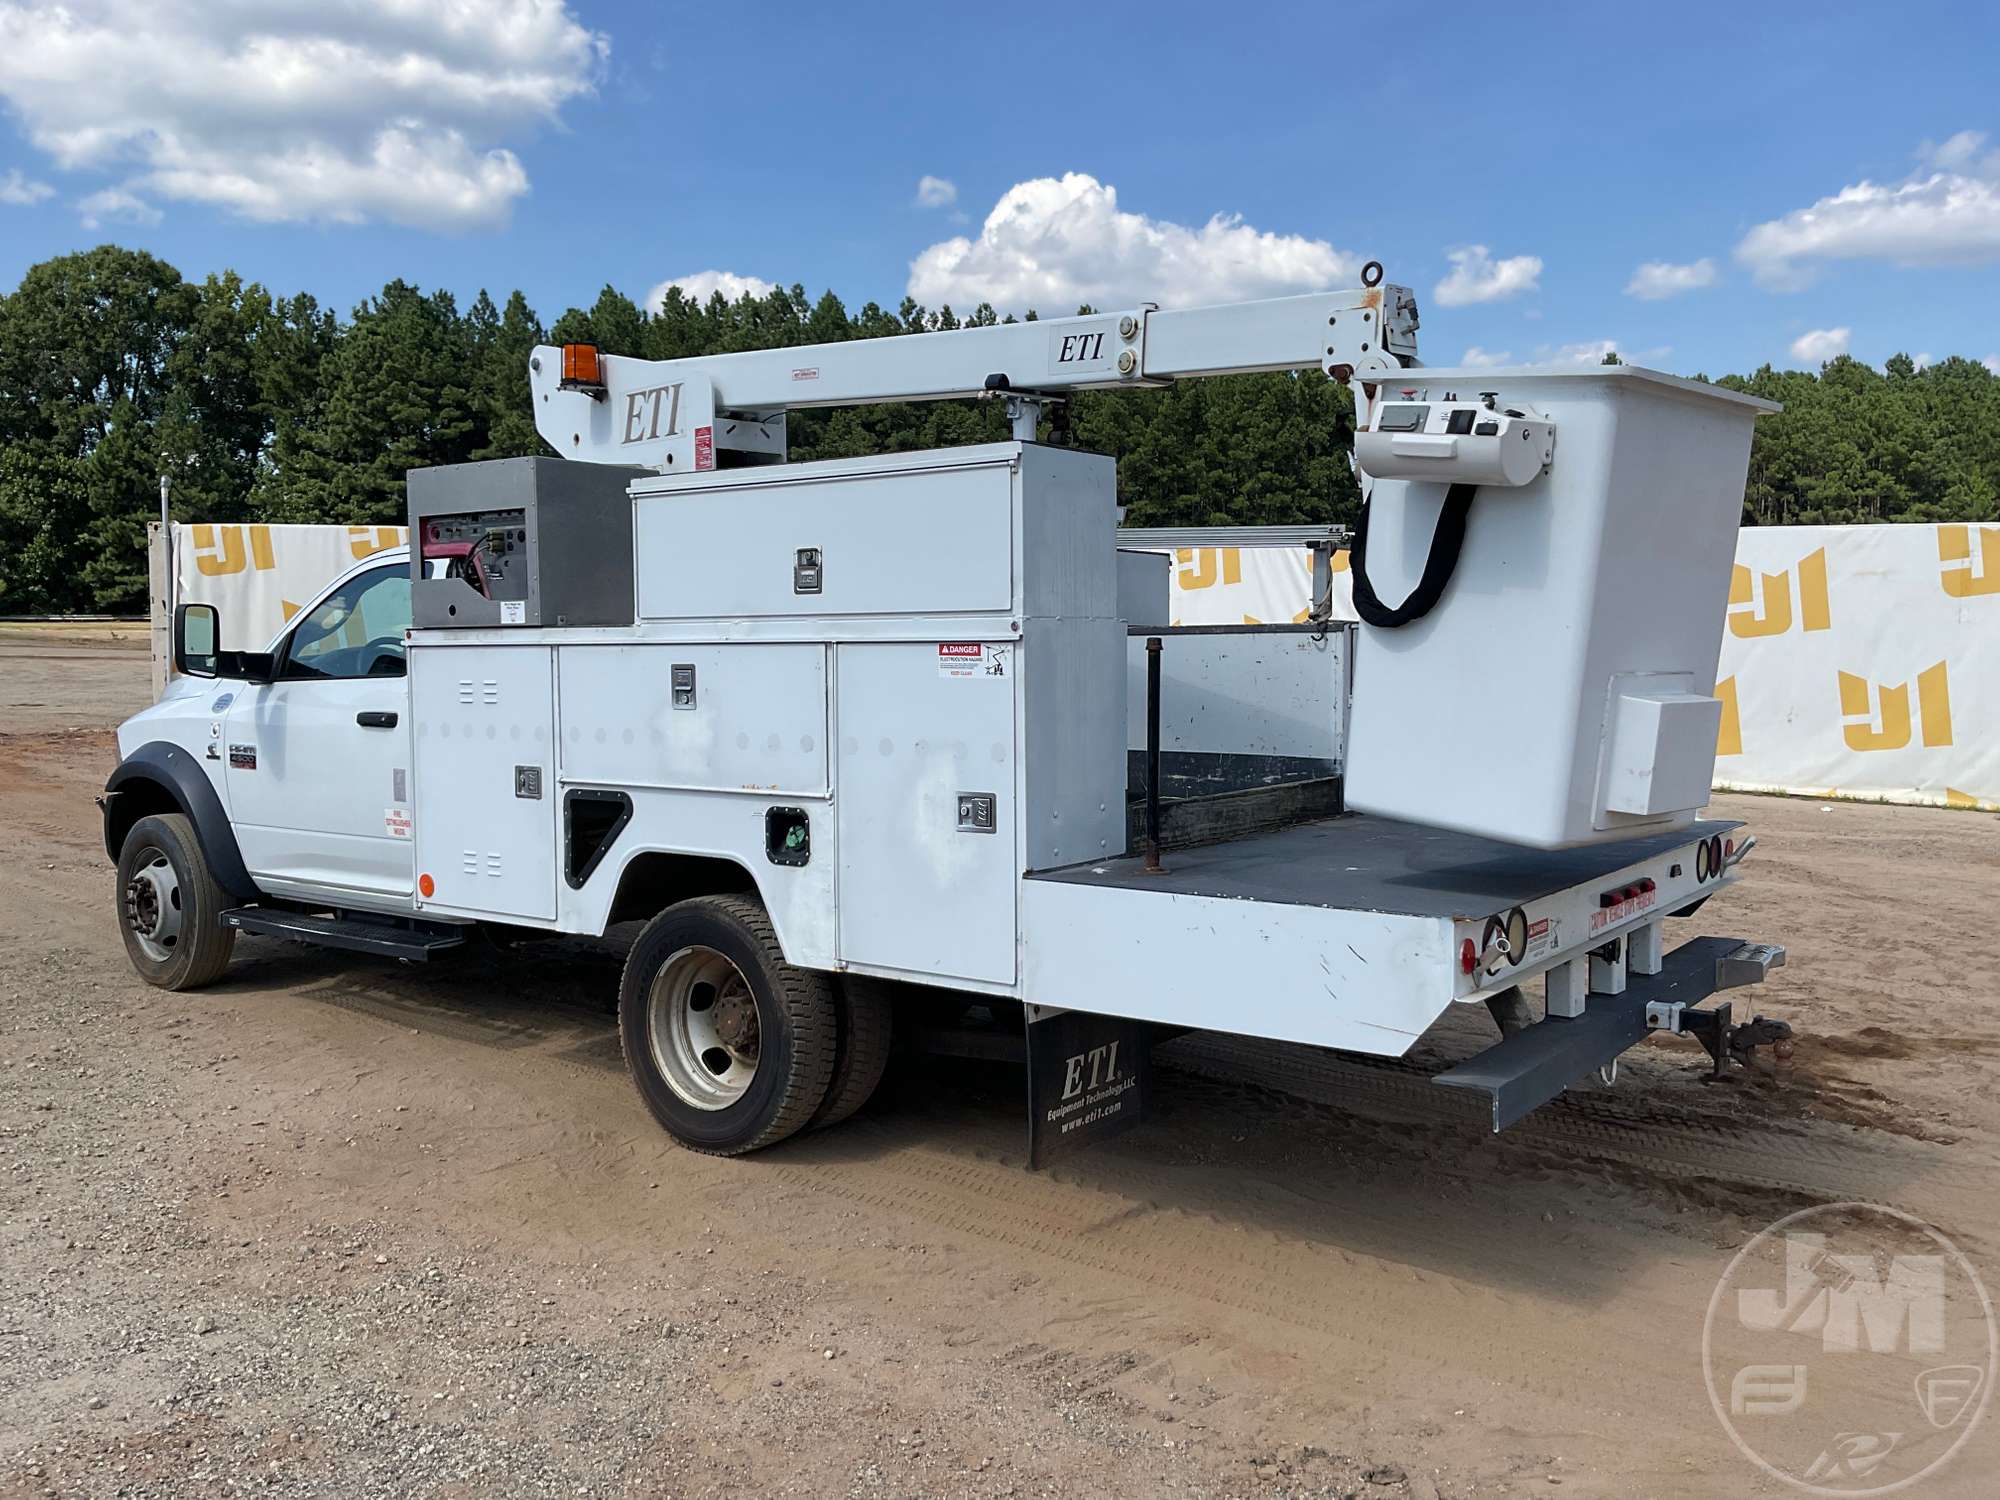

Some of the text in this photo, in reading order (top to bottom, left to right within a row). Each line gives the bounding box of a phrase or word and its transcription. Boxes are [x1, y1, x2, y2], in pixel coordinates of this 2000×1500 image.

[1057, 333, 1105, 363] ETI
[621, 382, 685, 445] ETI
[949, 645, 979, 654] DANGER
[1061, 1040, 1121, 1100] ETI
[1047, 1097, 1086, 1122] Equipment
